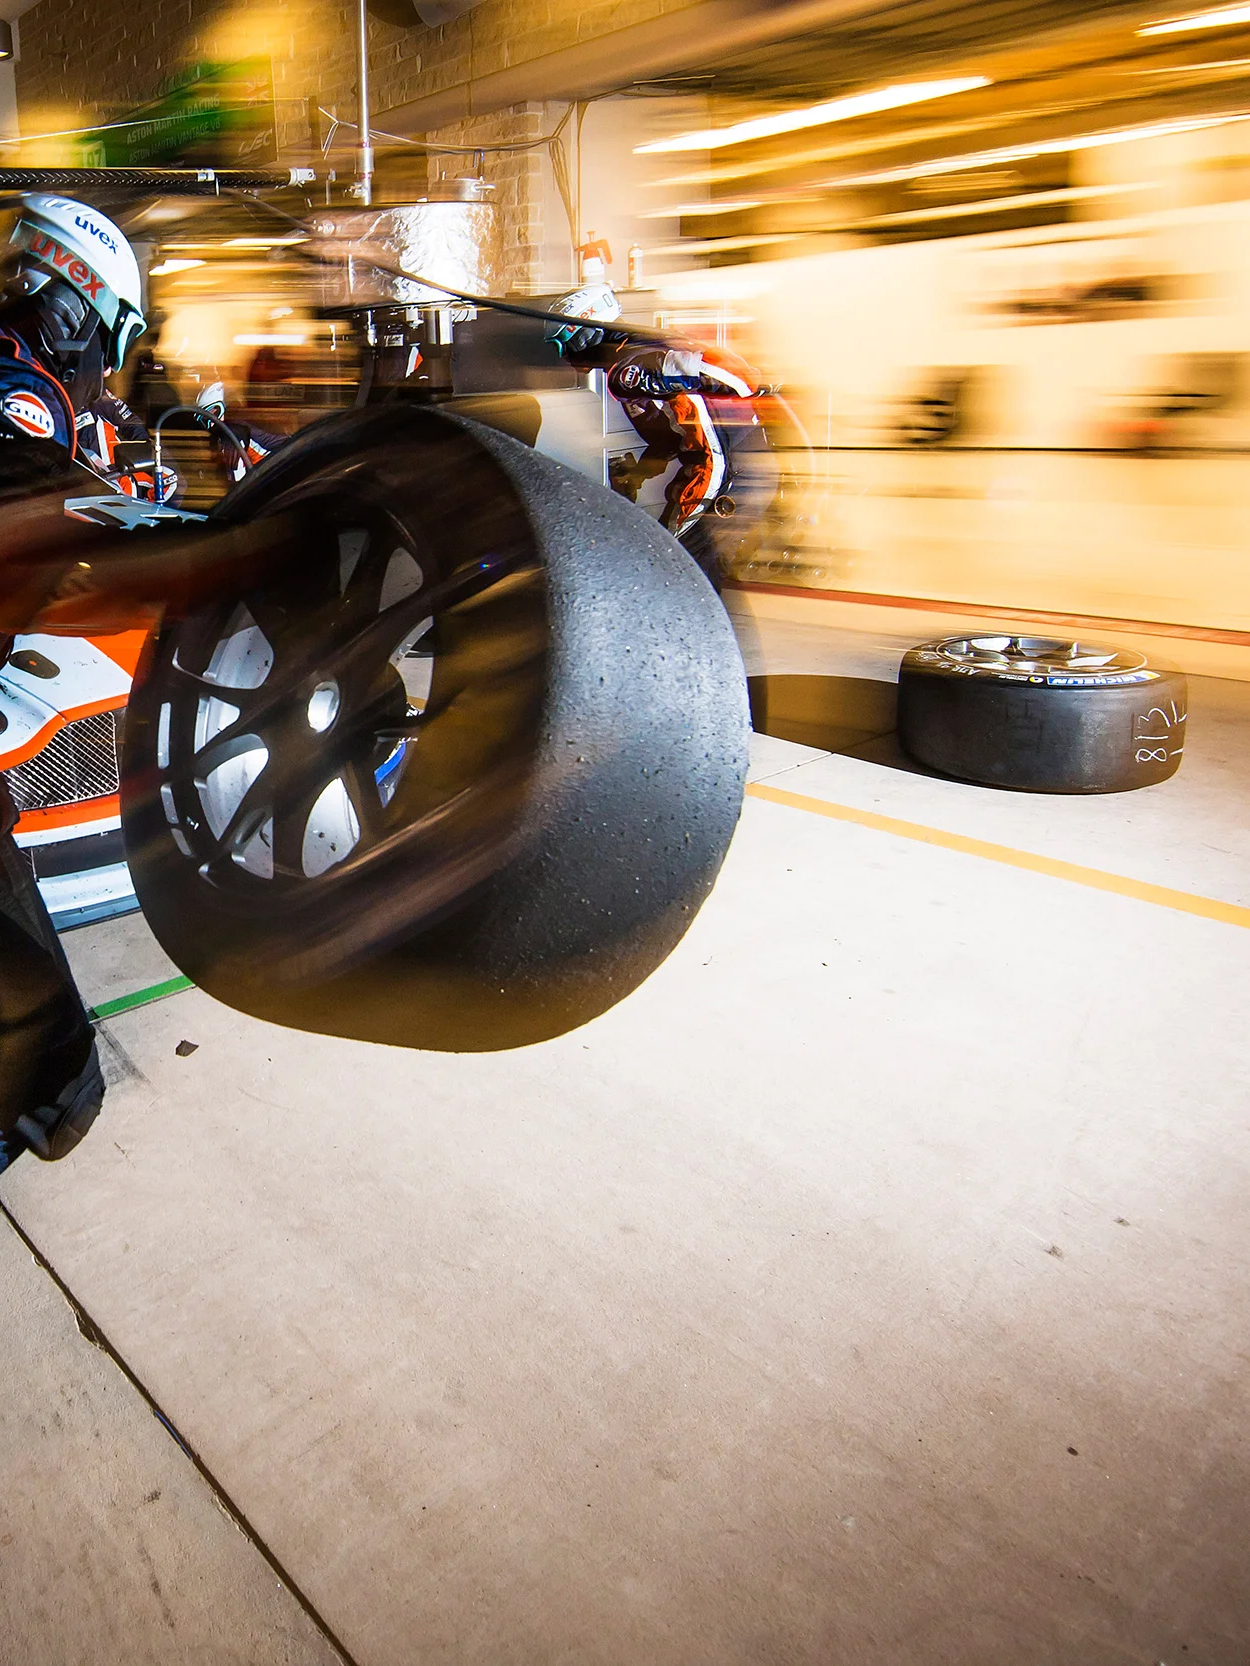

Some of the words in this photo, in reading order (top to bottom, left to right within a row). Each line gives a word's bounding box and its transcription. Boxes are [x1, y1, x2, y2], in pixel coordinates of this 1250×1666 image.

[127, 122, 152, 145] ASTON
[74, 215, 119, 255] uvex
[30, 232, 106, 301] uvex
[4, 400, 51, 430] Gulf
[1052, 674, 1138, 687] MICHELIN
